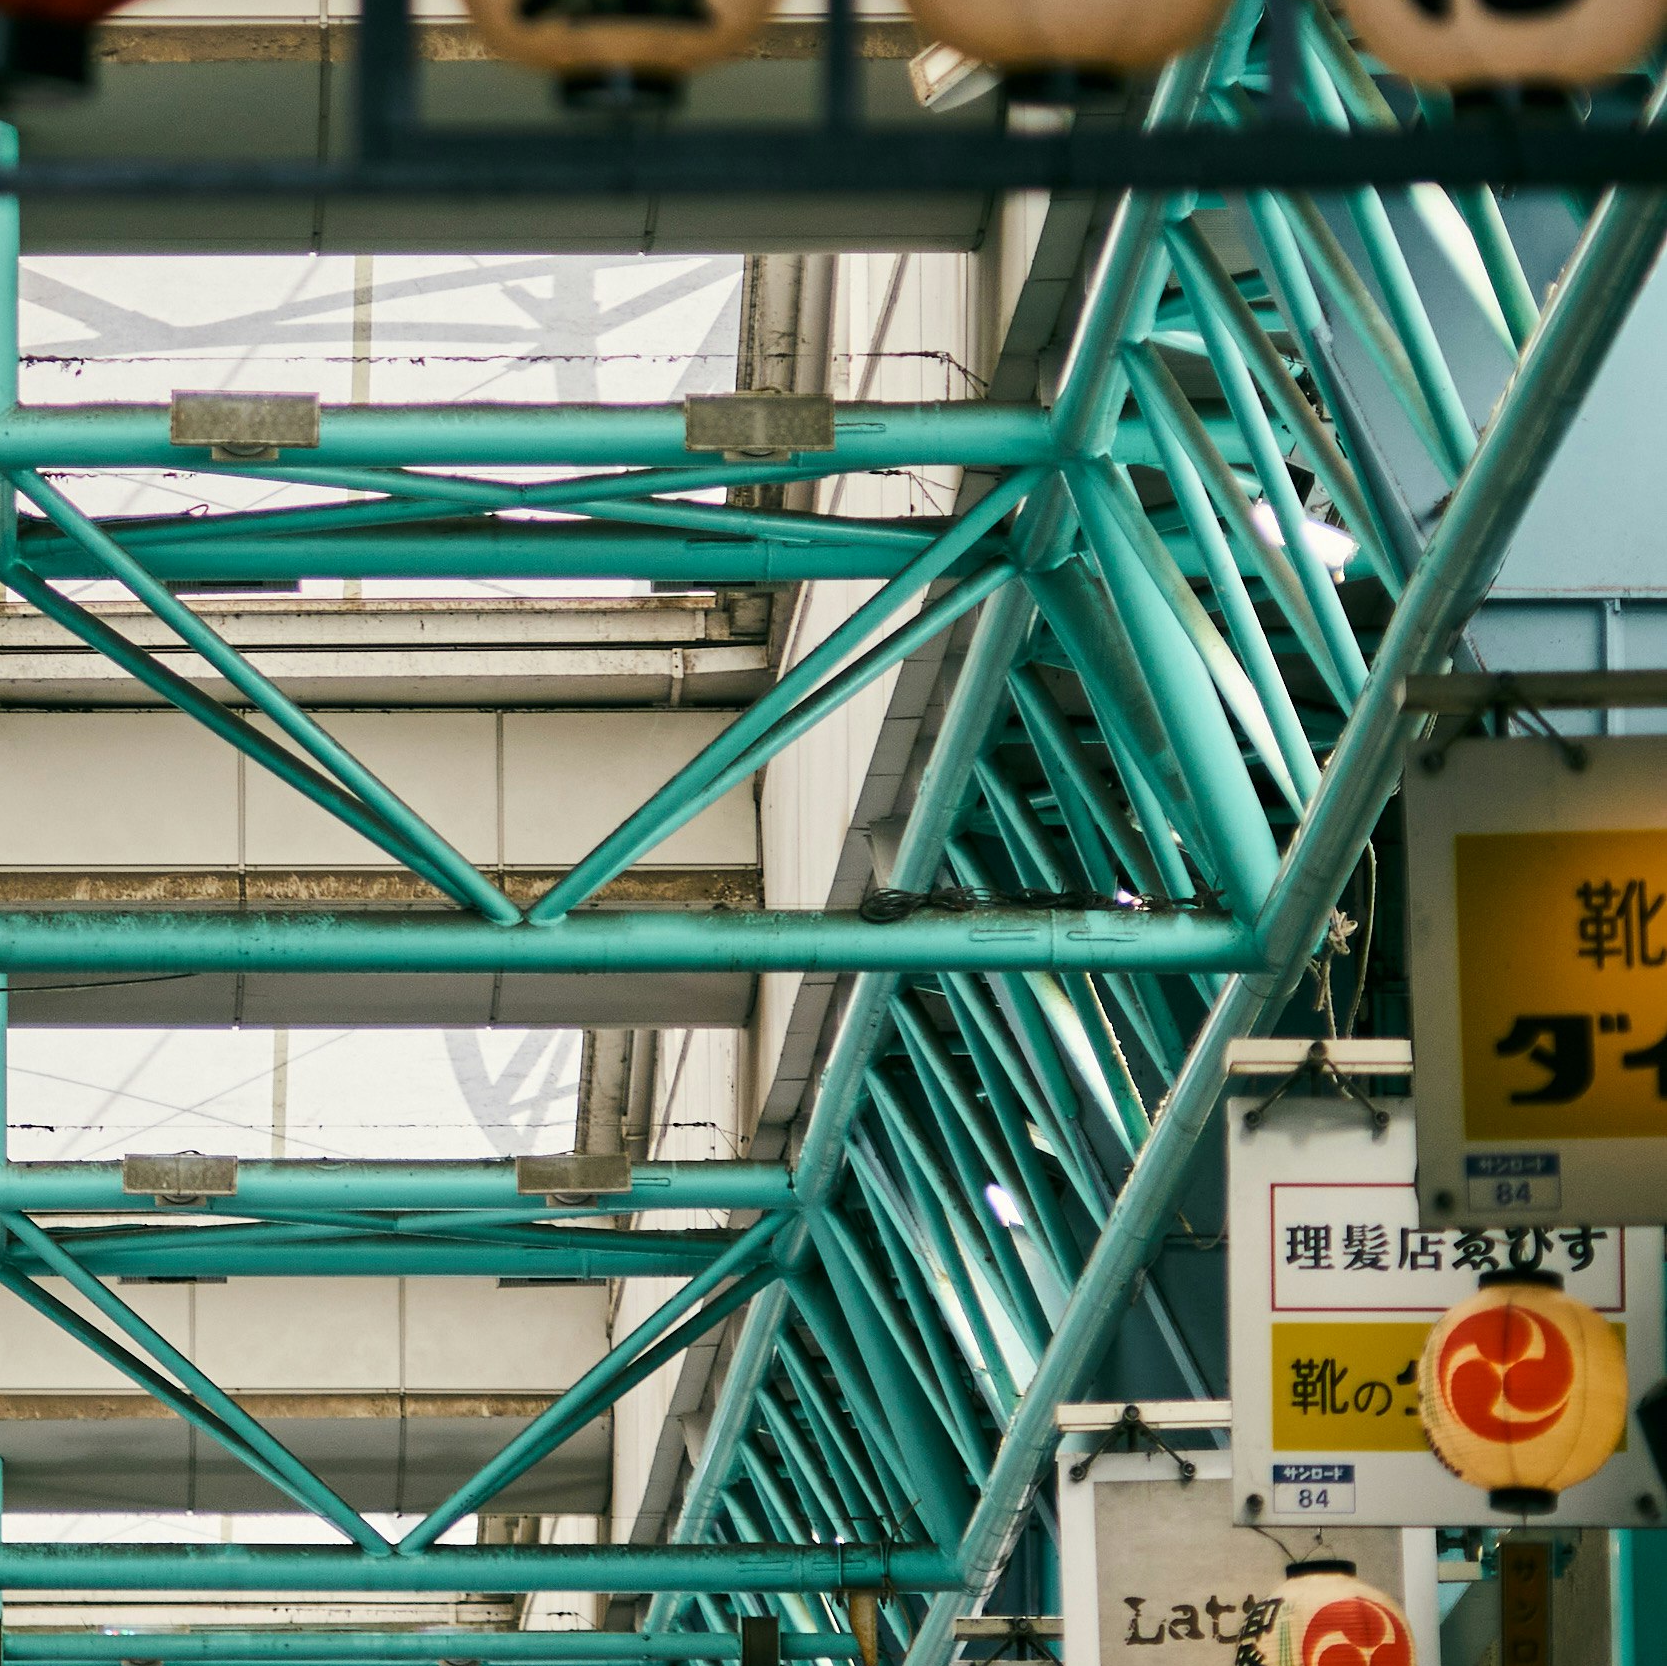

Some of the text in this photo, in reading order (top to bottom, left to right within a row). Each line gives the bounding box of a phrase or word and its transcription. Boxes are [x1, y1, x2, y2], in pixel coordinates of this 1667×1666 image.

[1494, 1182, 1533, 1205] 84
[1282, 1466, 1345, 1480] サンロード
[1297, 1489, 1330, 1509] 84
